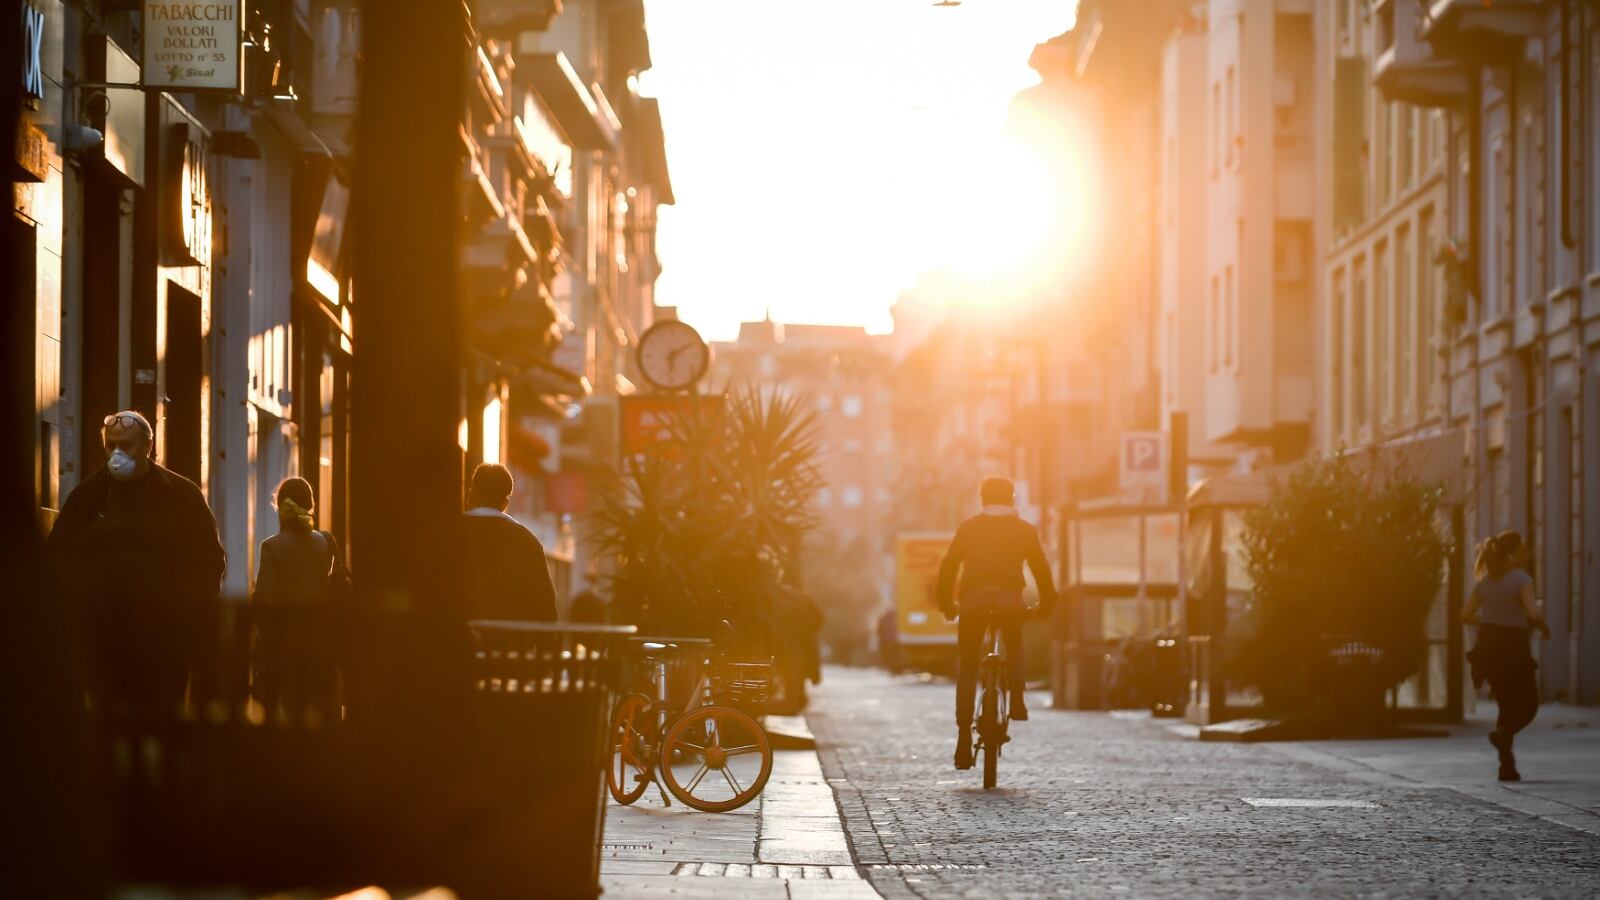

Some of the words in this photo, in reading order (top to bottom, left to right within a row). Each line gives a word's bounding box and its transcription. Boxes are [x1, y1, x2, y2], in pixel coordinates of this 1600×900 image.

[149, 4, 233, 20] TABACCHI
[167, 26, 214, 37] VALORI
[163, 37, 217, 49] BOLLATI
[154, 52, 193, 62] LOTTO
[185, 68, 215, 77] Sisal
[1134, 440, 1155, 467] P
